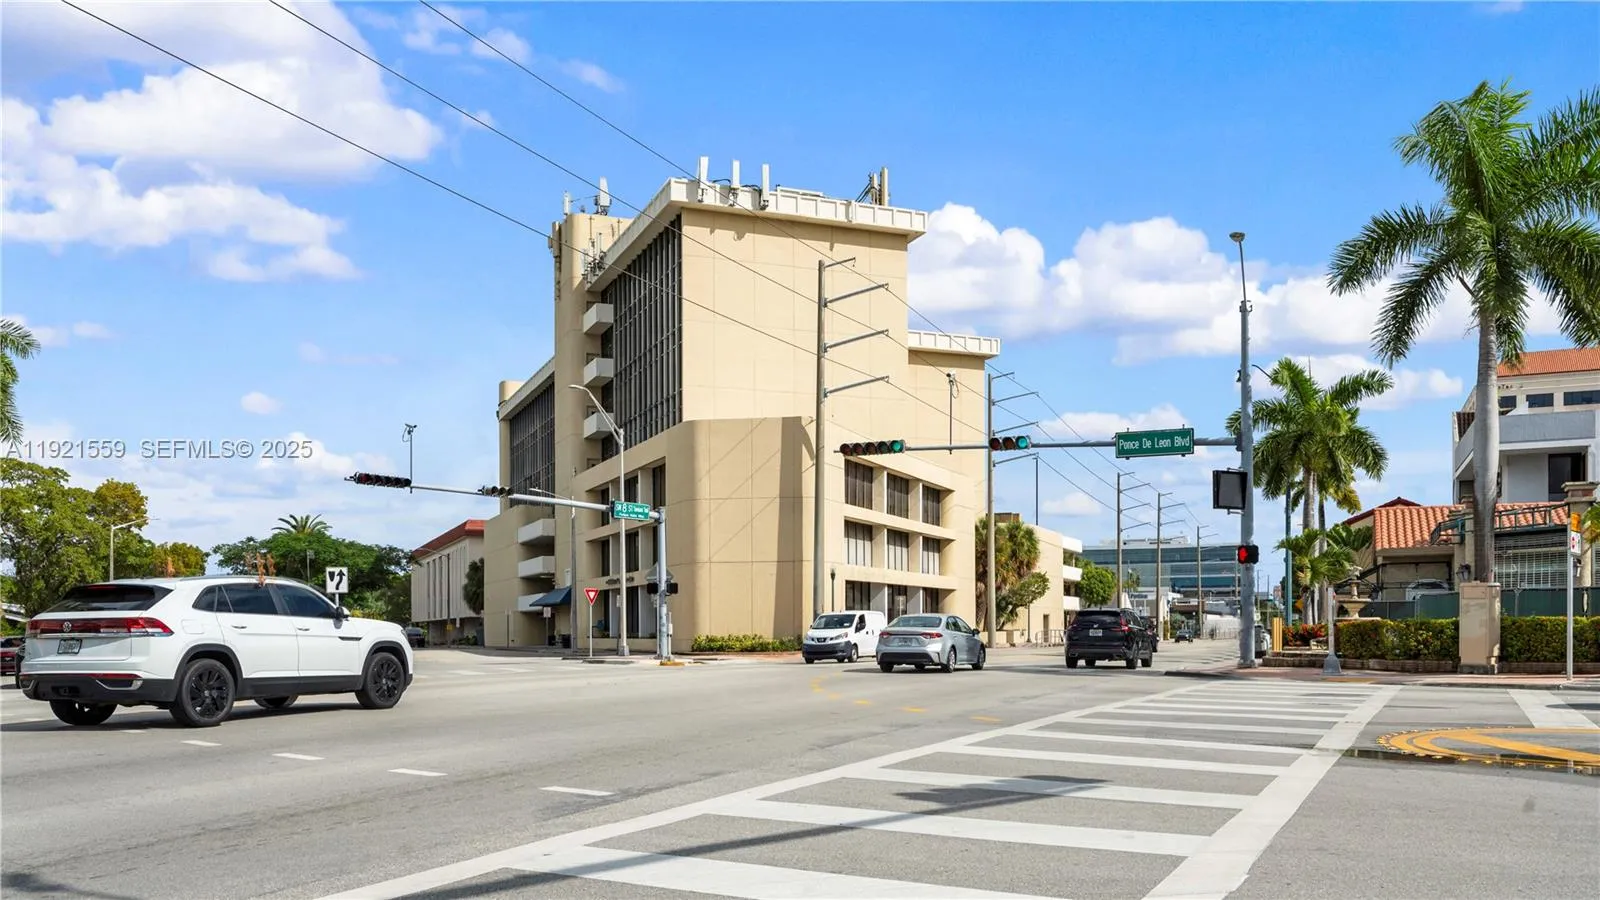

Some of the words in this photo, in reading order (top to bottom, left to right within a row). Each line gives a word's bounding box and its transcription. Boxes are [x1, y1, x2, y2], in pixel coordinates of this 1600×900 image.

[1120, 439, 1139, 450] Ponce
[1142, 438, 1152, 449] De
[1154, 437, 1171, 448] Leon
[1174, 435, 1190, 447] Blvd
[622, 503, 627, 512] 8
